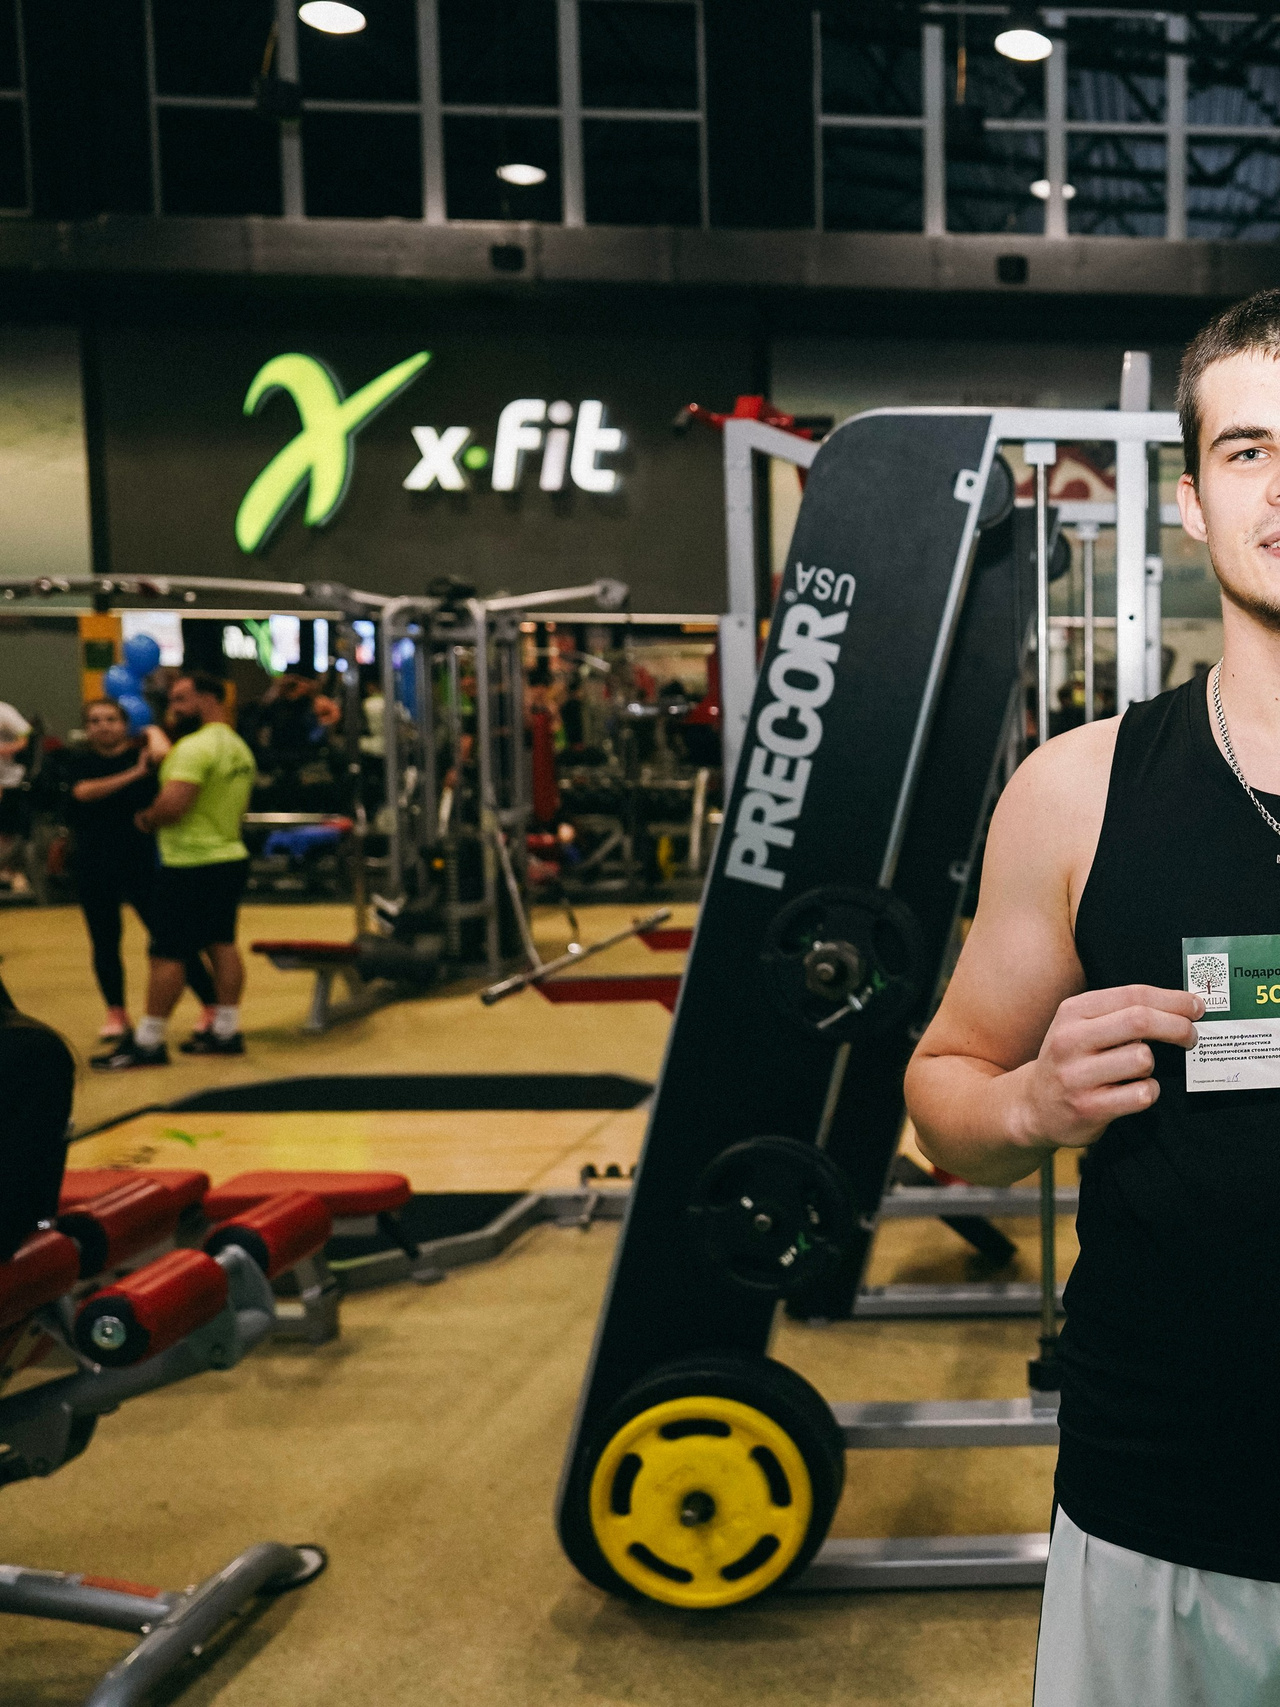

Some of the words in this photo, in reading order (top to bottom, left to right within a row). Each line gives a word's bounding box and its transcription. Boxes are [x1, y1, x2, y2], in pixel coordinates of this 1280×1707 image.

[794, 561, 857, 607] USA
[725, 603, 850, 891] PRECOR
[1203, 996, 1228, 1005] MILIA
[1229, 1032, 1272, 1040] профилактика
